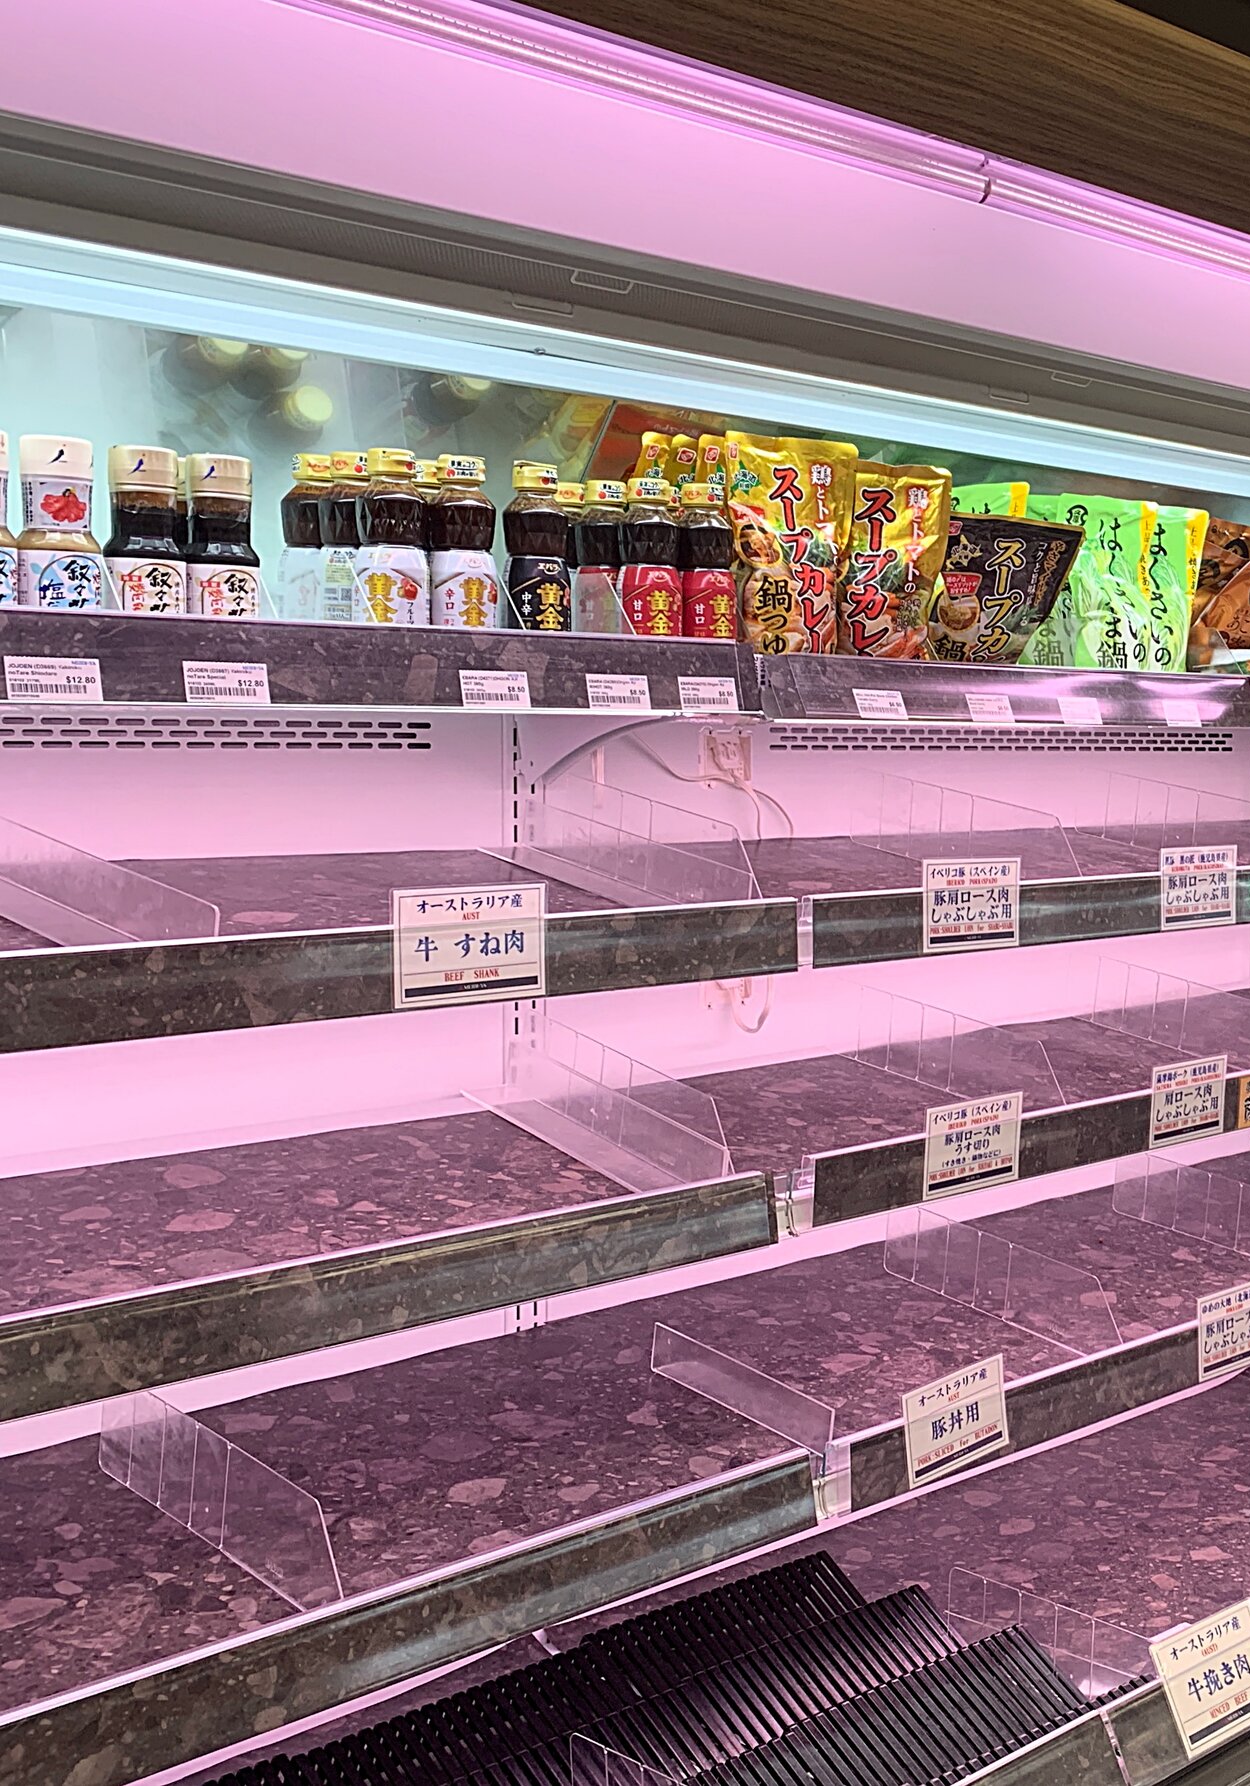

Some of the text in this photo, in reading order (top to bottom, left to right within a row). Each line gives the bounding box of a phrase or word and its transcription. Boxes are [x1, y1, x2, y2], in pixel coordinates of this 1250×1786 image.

[904, 487, 929, 594] 鶏とトマトの
[537, 562, 561, 575] エバラ
[847, 488, 898, 657] スープカレ
[364, 572, 399, 623] 黄金
[444, 588, 455, 611] 辛口
[459, 576, 489, 628] 黄金
[521, 591, 533, 616] 中辛
[536, 582, 565, 631] 黄金
[632, 599, 644, 622] 甘口
[646, 589, 674, 636] 黄金
[694, 603, 706, 625] 甘口
[709, 594, 734, 638] 黄金
[66, 676, 96, 684] $12.80
[237, 679, 264, 687] $12.80
[930, 866, 966, 879] イベリコ豚
[1168, 872, 1227, 890] 豚肩ロース肉
[417, 893, 523, 914] オーストラリア産
[934, 887, 1009, 906] 豚肩ロース肉
[1166, 886, 1229, 905] しゃぶしゃぶ用
[461, 911, 480, 921] AUST
[931, 903, 1012, 924] しゃぶしゃぶ用
[414, 929, 525, 962] 牛 すね肉
[444, 968, 500, 983] BEEF SHANK
[1164, 1084, 1212, 1106] 肩ロース肉
[933, 1108, 967, 1125] イベリコ豚
[1156, 1096, 1218, 1122] しゃぶしゃぶ用
[944, 1124, 1000, 1146] 豚肩ロース肉
[955, 1139, 990, 1155] うす切り
[918, 1368, 987, 1406] オーストラリア産
[948, 1391, 960, 1402] AUST
[931, 1401, 980, 1440] 豚丼用
[960, 1424, 998, 1447] for BUTADON
[1170, 1616, 1241, 1661] オーストラリア産
[1210, 1692, 1248, 1719] MINCED BEEF
